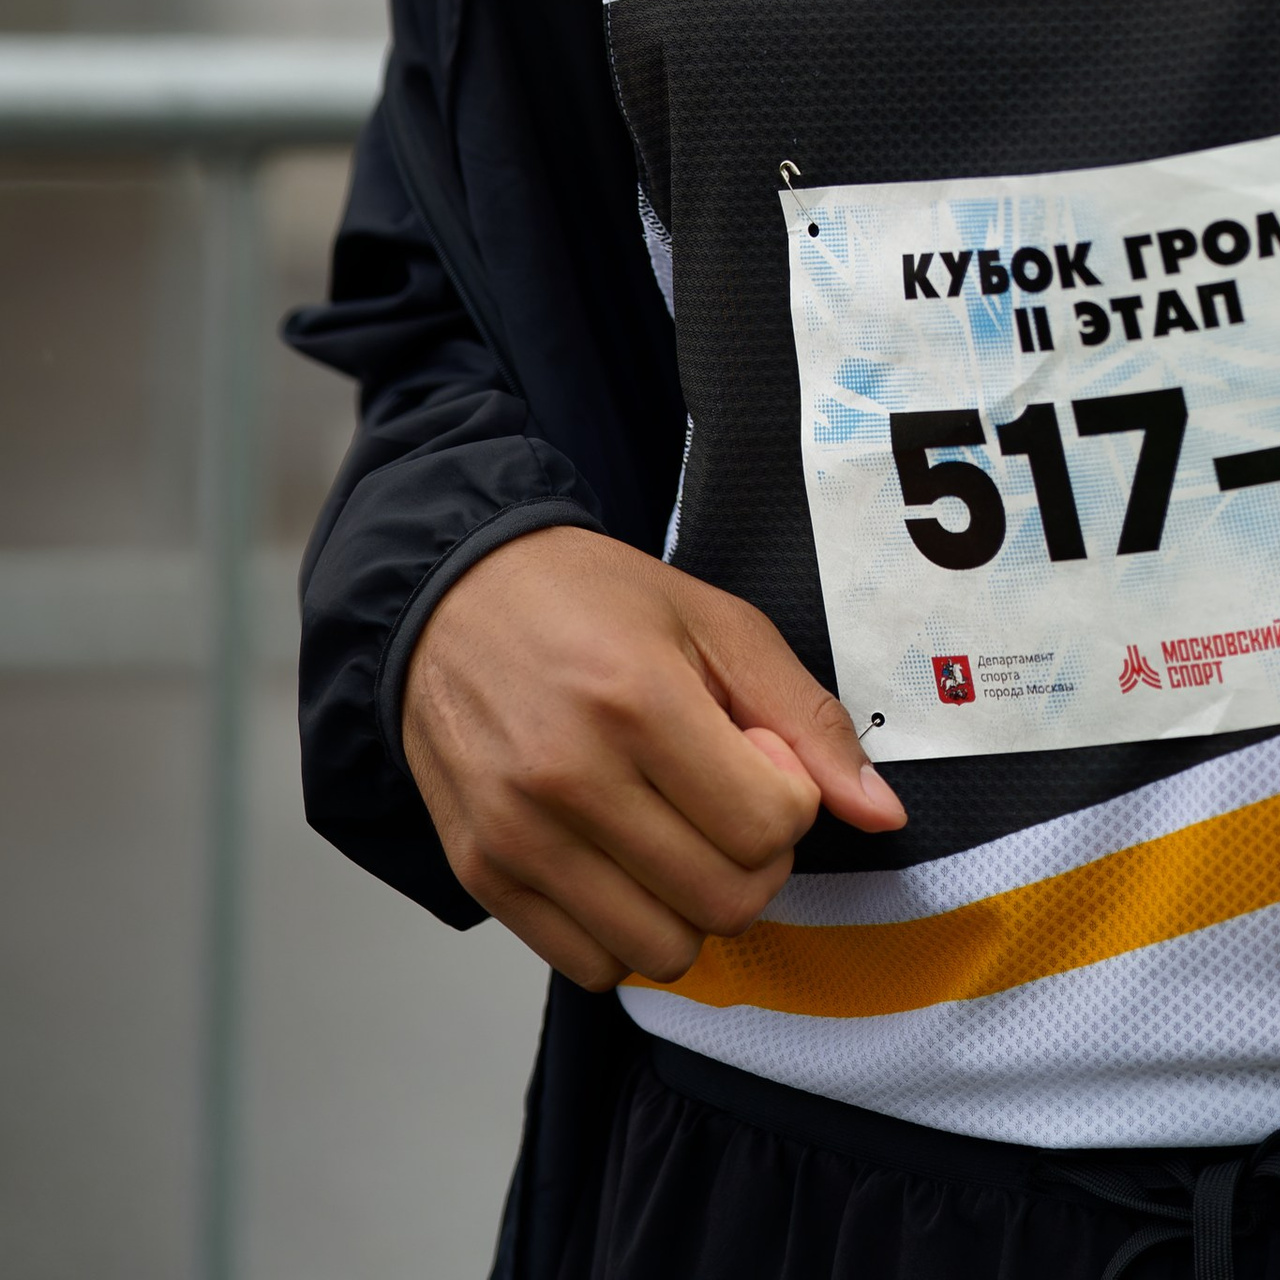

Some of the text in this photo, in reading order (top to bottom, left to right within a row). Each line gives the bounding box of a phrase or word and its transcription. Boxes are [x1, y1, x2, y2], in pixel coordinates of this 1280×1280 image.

[902, 241, 1103, 300] КУБОК
[1074, 279, 1245, 347] ЭТАП
[978, 652, 1054, 669] Департамент
[981, 671, 1020, 685] спорта
[1167, 661, 1224, 689] СПОРТ
[984, 682, 1075, 701] города Москвы
